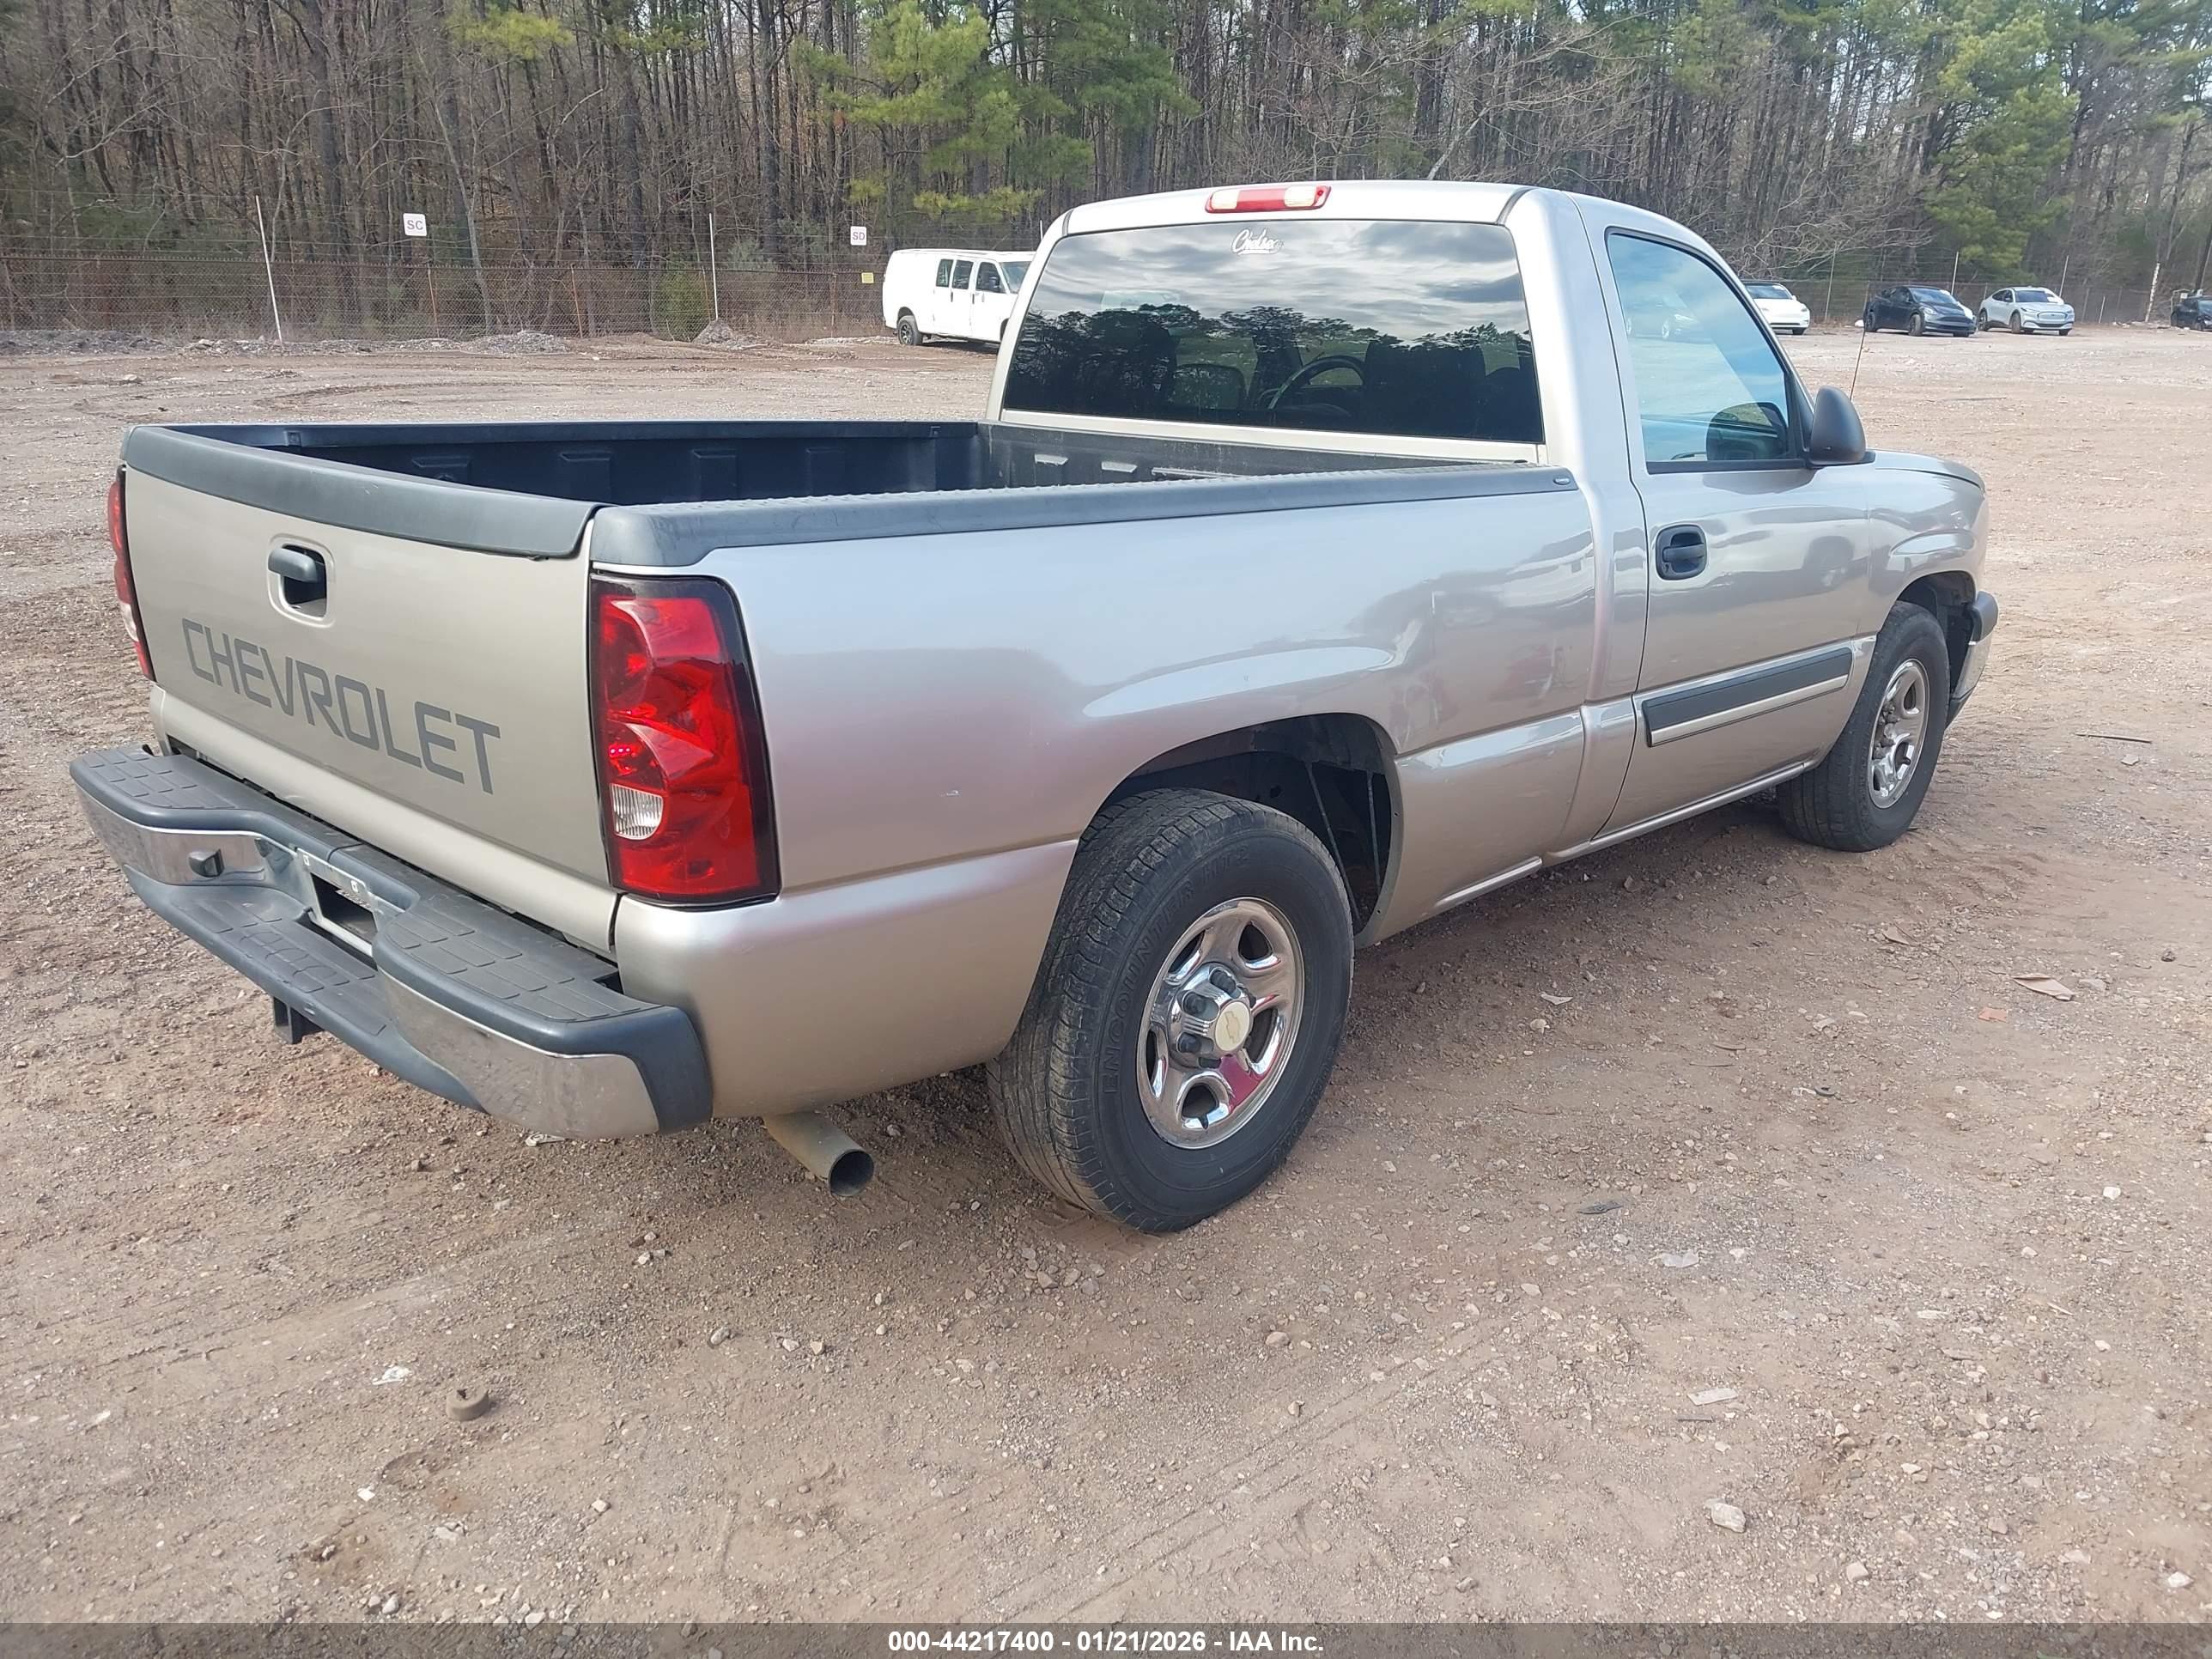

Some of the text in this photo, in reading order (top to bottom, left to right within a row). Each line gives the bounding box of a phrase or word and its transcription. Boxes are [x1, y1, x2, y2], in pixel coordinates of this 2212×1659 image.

[407, 220, 423, 230] SC
[852, 232, 866, 240] SD
[182, 617, 501, 795] CHEVROLET
[1103, 879, 1194, 1093] ENCOUNTER
